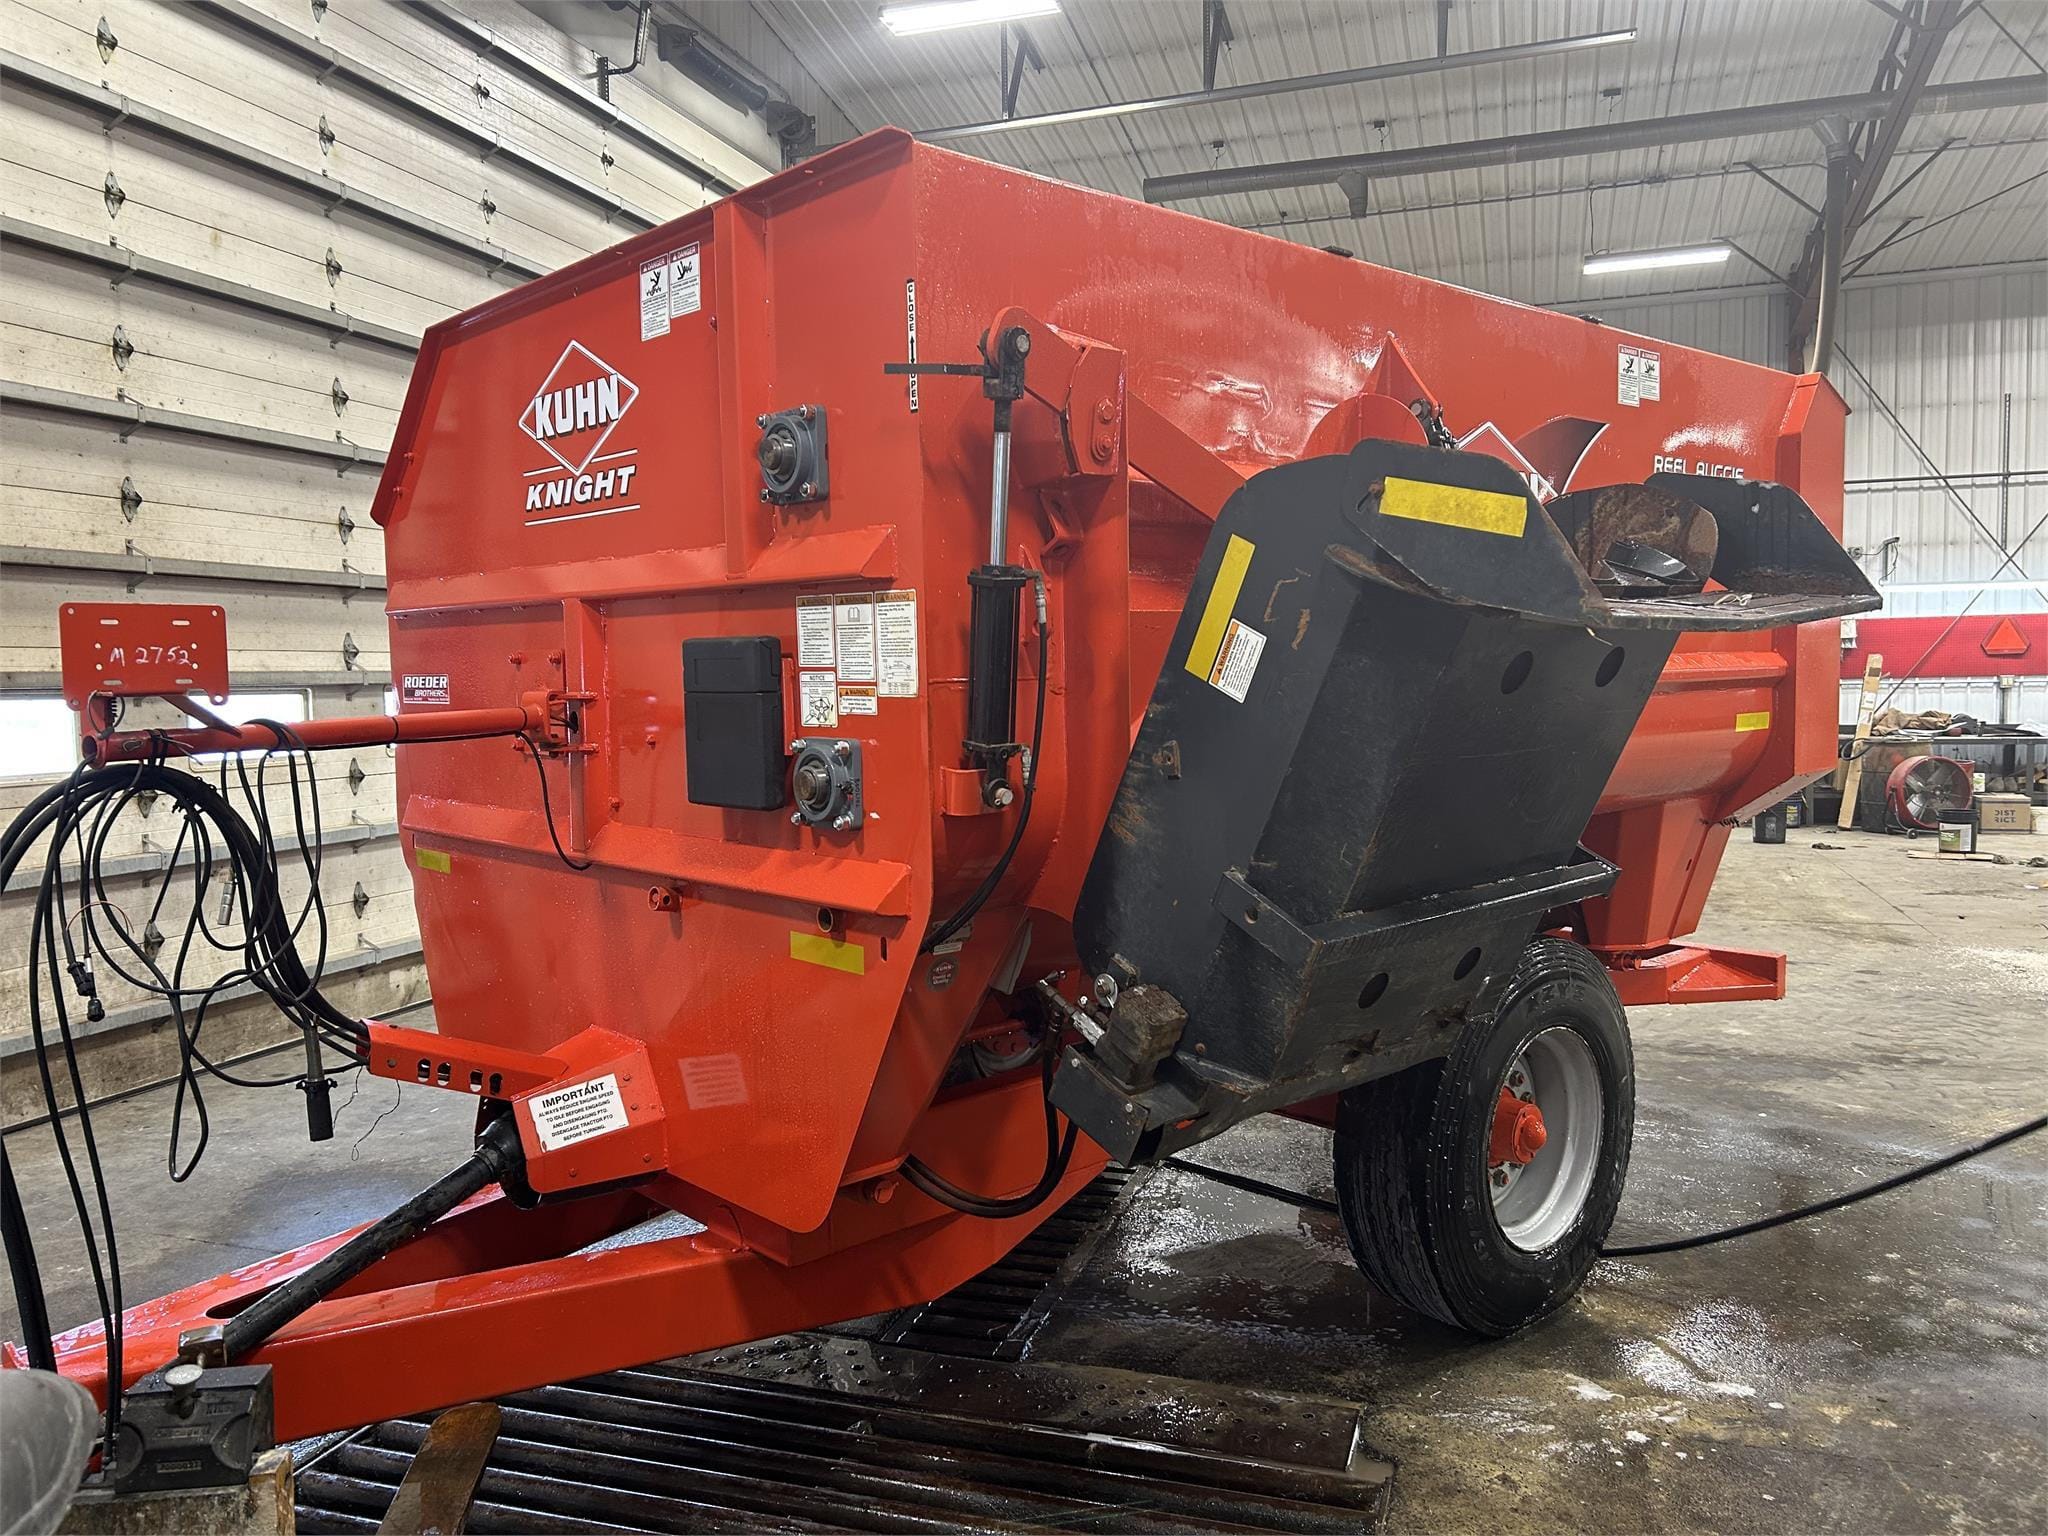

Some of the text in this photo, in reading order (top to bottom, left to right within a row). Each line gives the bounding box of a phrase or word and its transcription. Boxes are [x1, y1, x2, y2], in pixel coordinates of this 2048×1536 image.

[677, 247, 696, 259] DANGER
[647, 258, 665, 270] DANGER
[534, 373, 619, 440] KUHN
[525, 465, 636, 512] KNIGHT
[109, 645, 191, 667] M 2752
[1219, 634, 1234, 666] WARNING
[404, 676, 447, 688] ROEDER
[538, 1090, 614, 1118] ALWAYS REDUCE ENGINE SPEED
[542, 1082, 604, 1108] IMPORTANT
[565, 1108, 585, 1117] BEFORE
[585, 1099, 610, 1111] ENGAGING
[551, 1124, 580, 1137] DISENGAGE
[580, 1117, 603, 1127] TRACTOR
[564, 1112, 597, 1126] DISENGAGING
[563, 1132, 582, 1141] BEFORE
